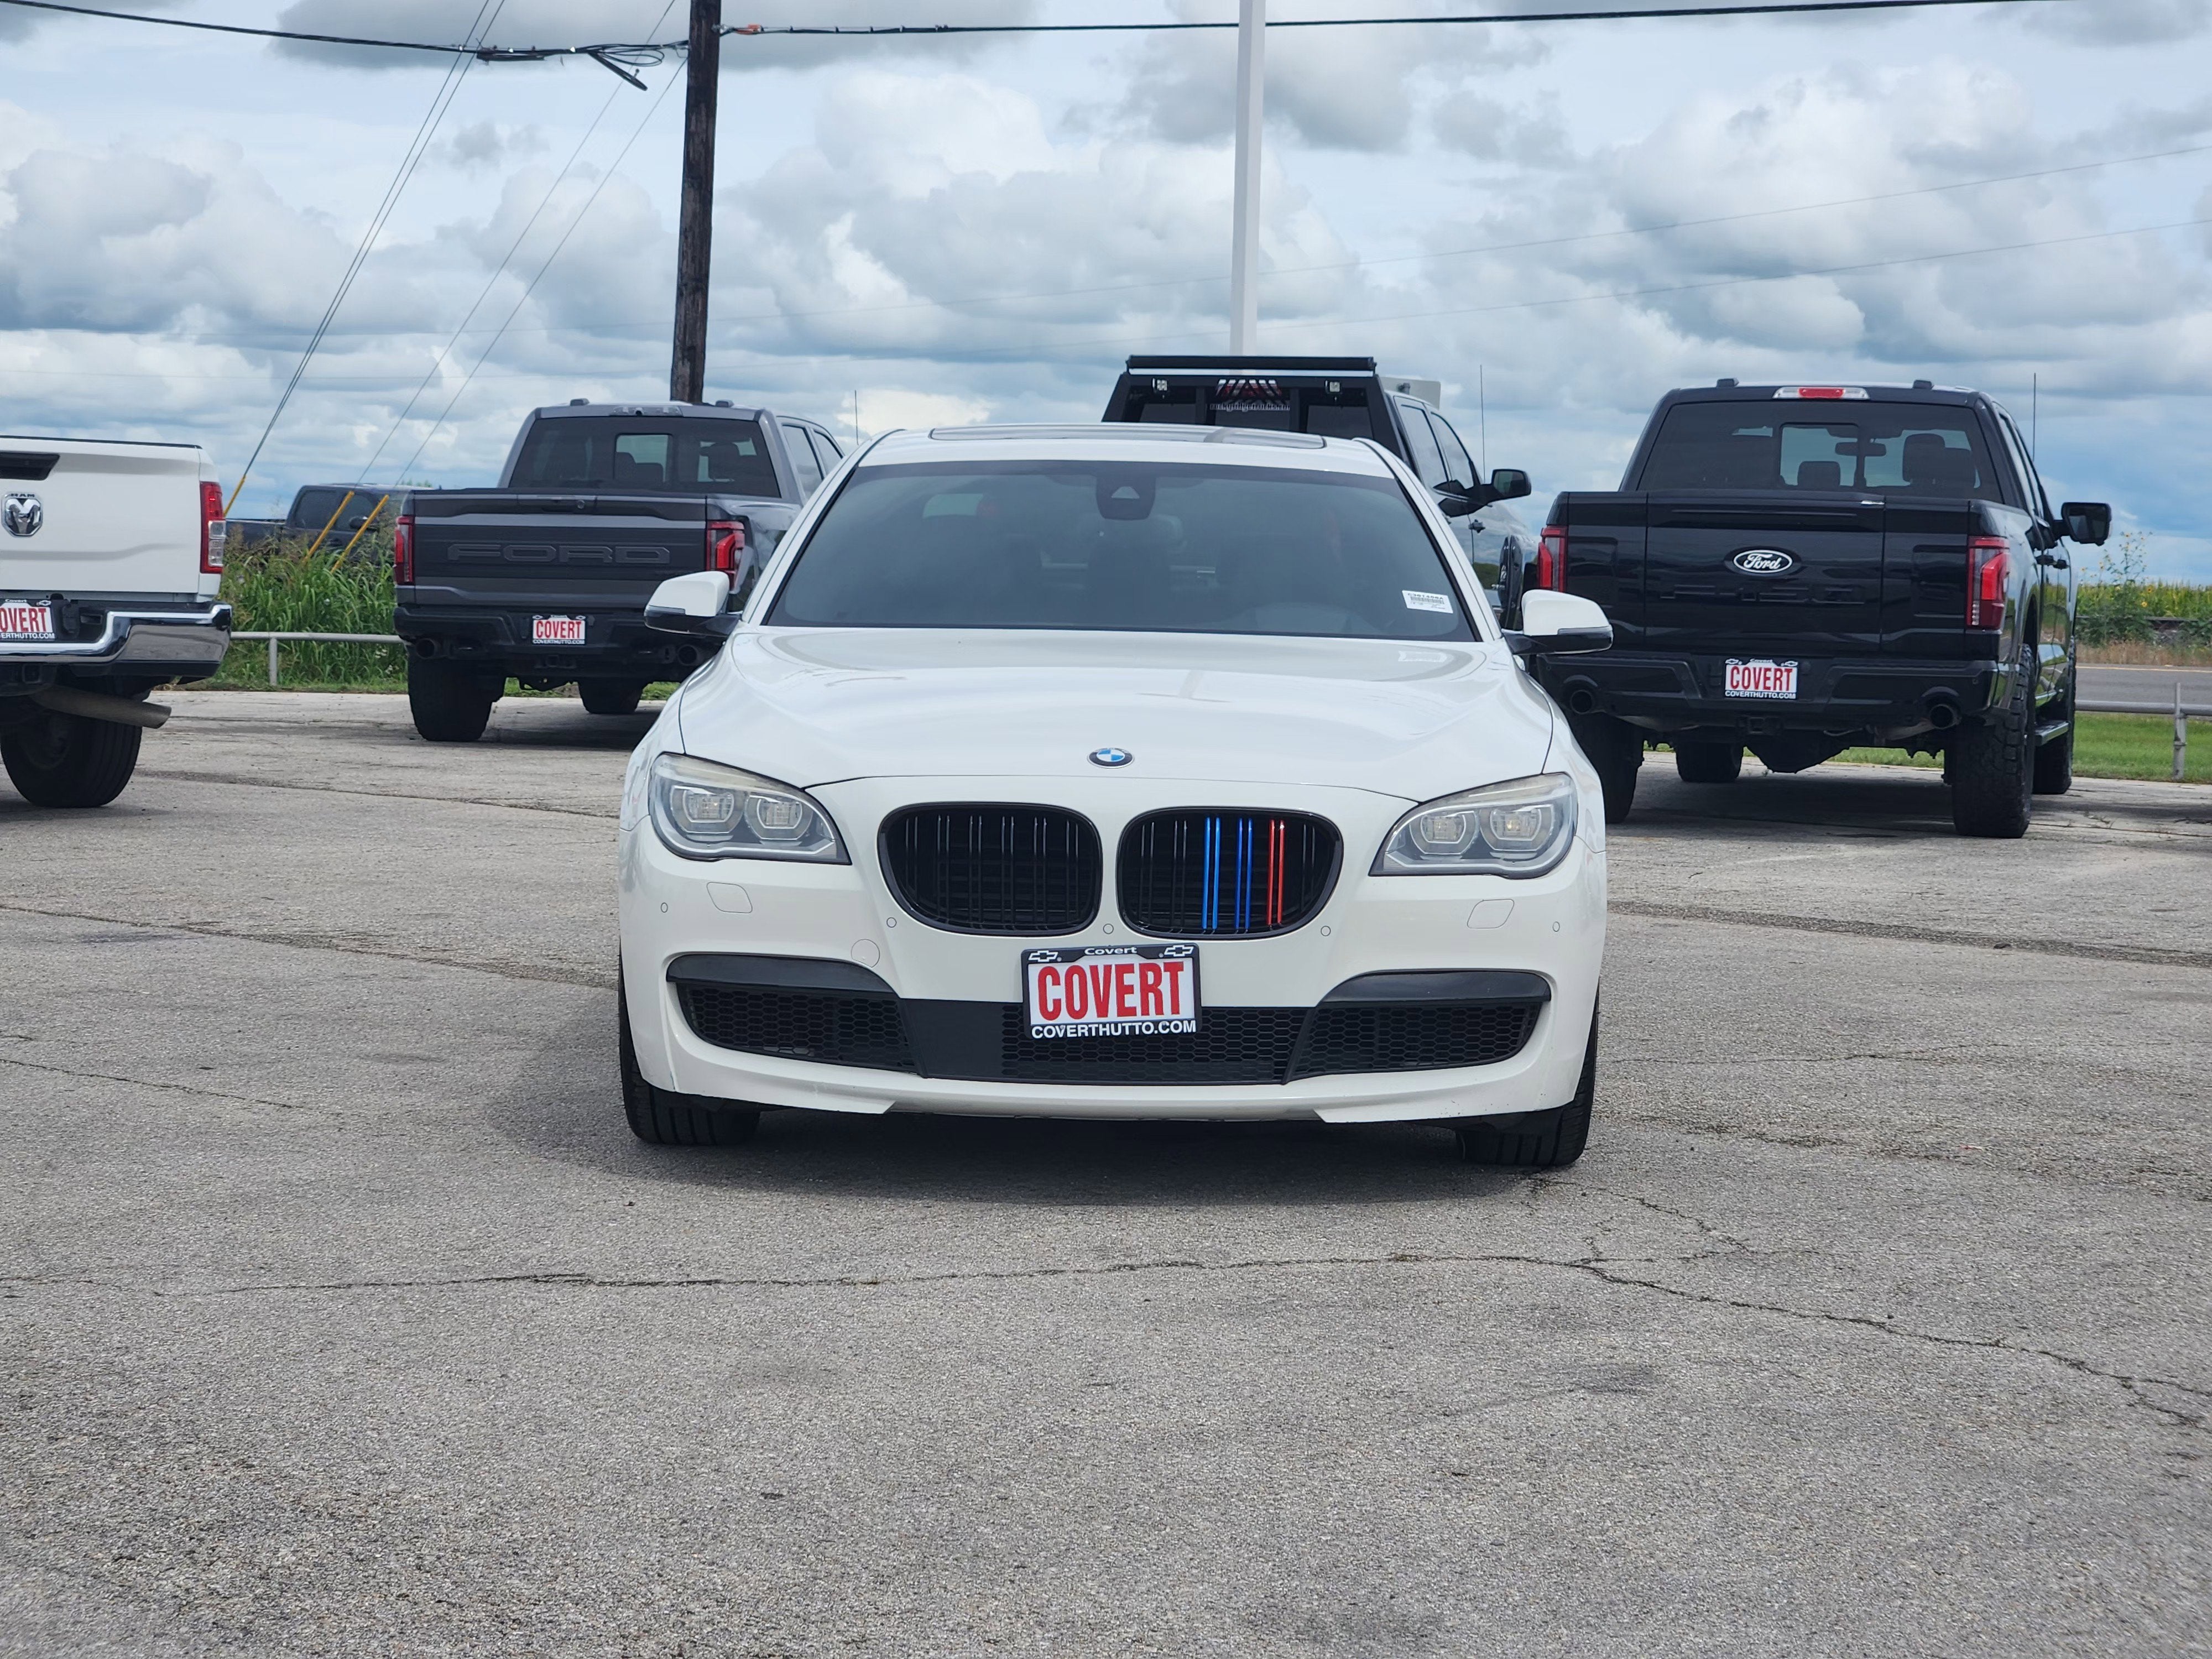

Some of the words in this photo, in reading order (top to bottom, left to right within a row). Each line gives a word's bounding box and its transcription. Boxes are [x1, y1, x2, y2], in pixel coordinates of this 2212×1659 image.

[447, 544, 670, 563] FORD
[1744, 553, 1782, 570] Ford
[536, 620, 581, 638] COVERT
[1730, 666, 1792, 691] COVERT
[1725, 691, 1796, 699] COVERTHUTTO.COM
[1084, 946, 1137, 956] Covert
[1037, 961, 1184, 1021] COVERT
[1031, 1020, 1196, 1039] COVERTHUTTO.COM
